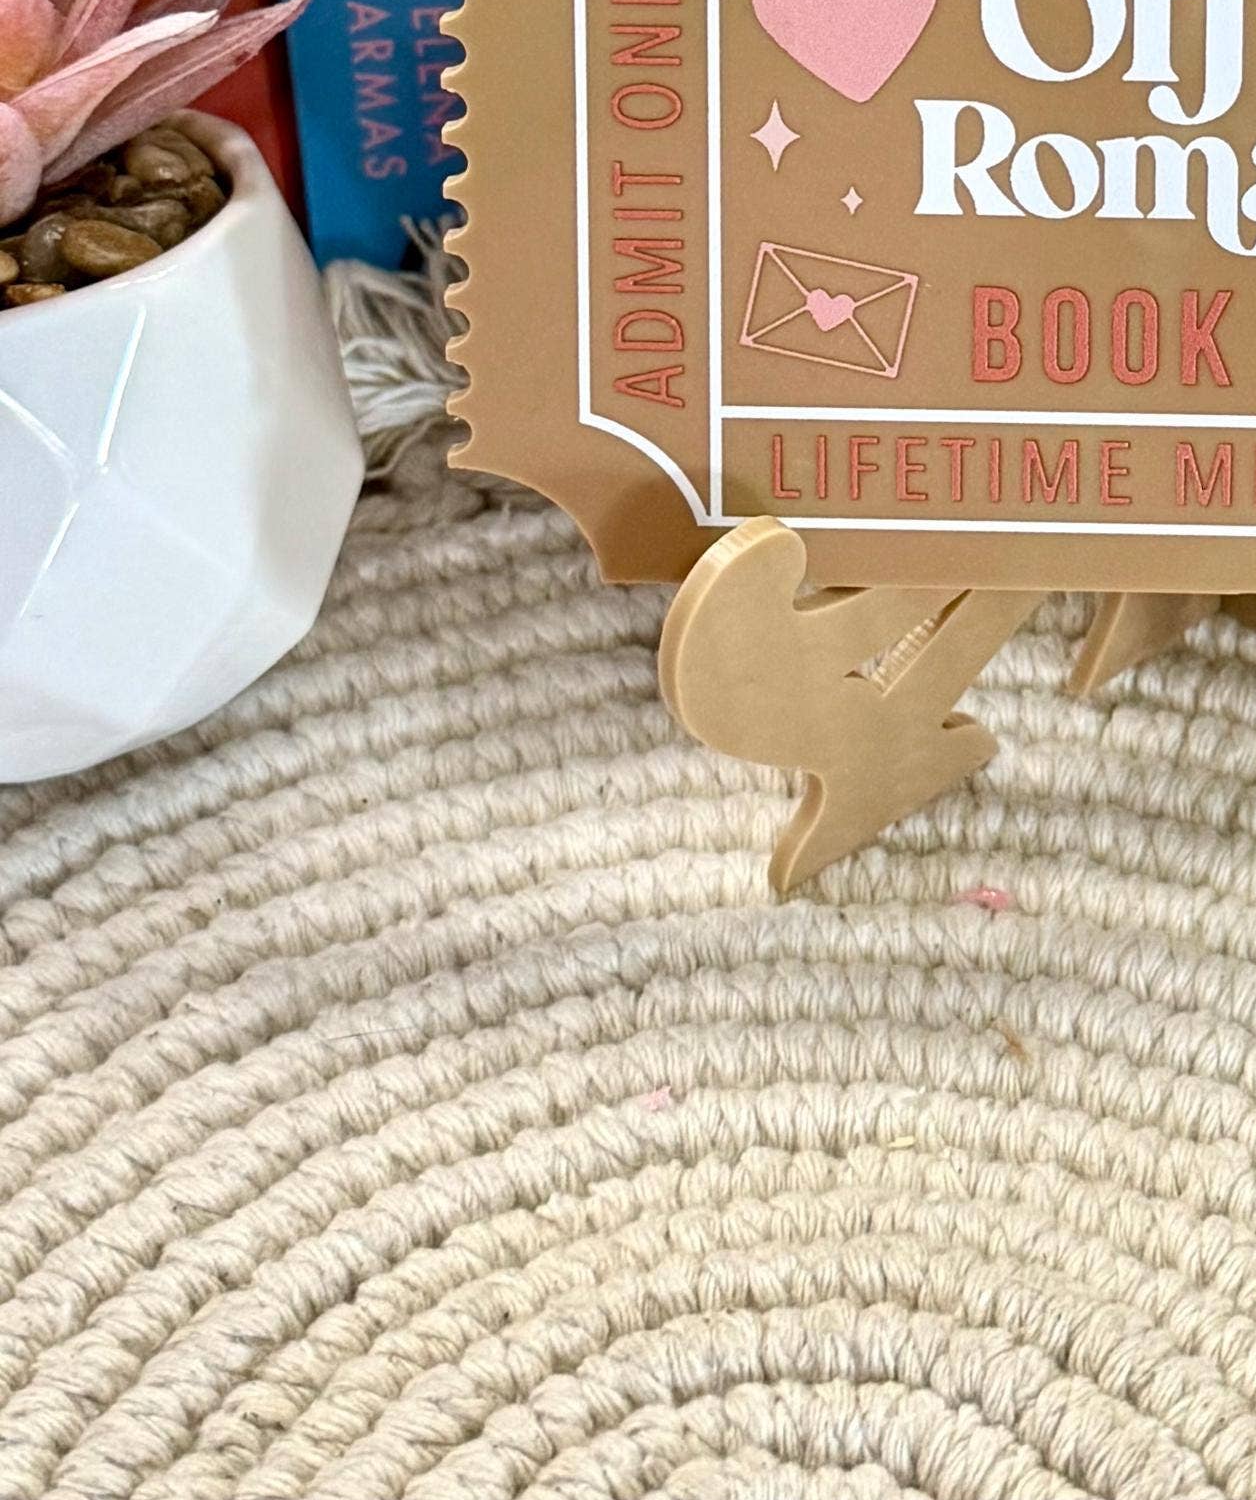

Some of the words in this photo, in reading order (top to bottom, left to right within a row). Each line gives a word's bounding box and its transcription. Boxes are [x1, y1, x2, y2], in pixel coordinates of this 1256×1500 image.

[345, 0, 409, 181] ARMAS
[612, 159, 688, 409] ADMIT
[971, 284, 1235, 388] BOOK
[770, 433, 1133, 506] LIFETIME
